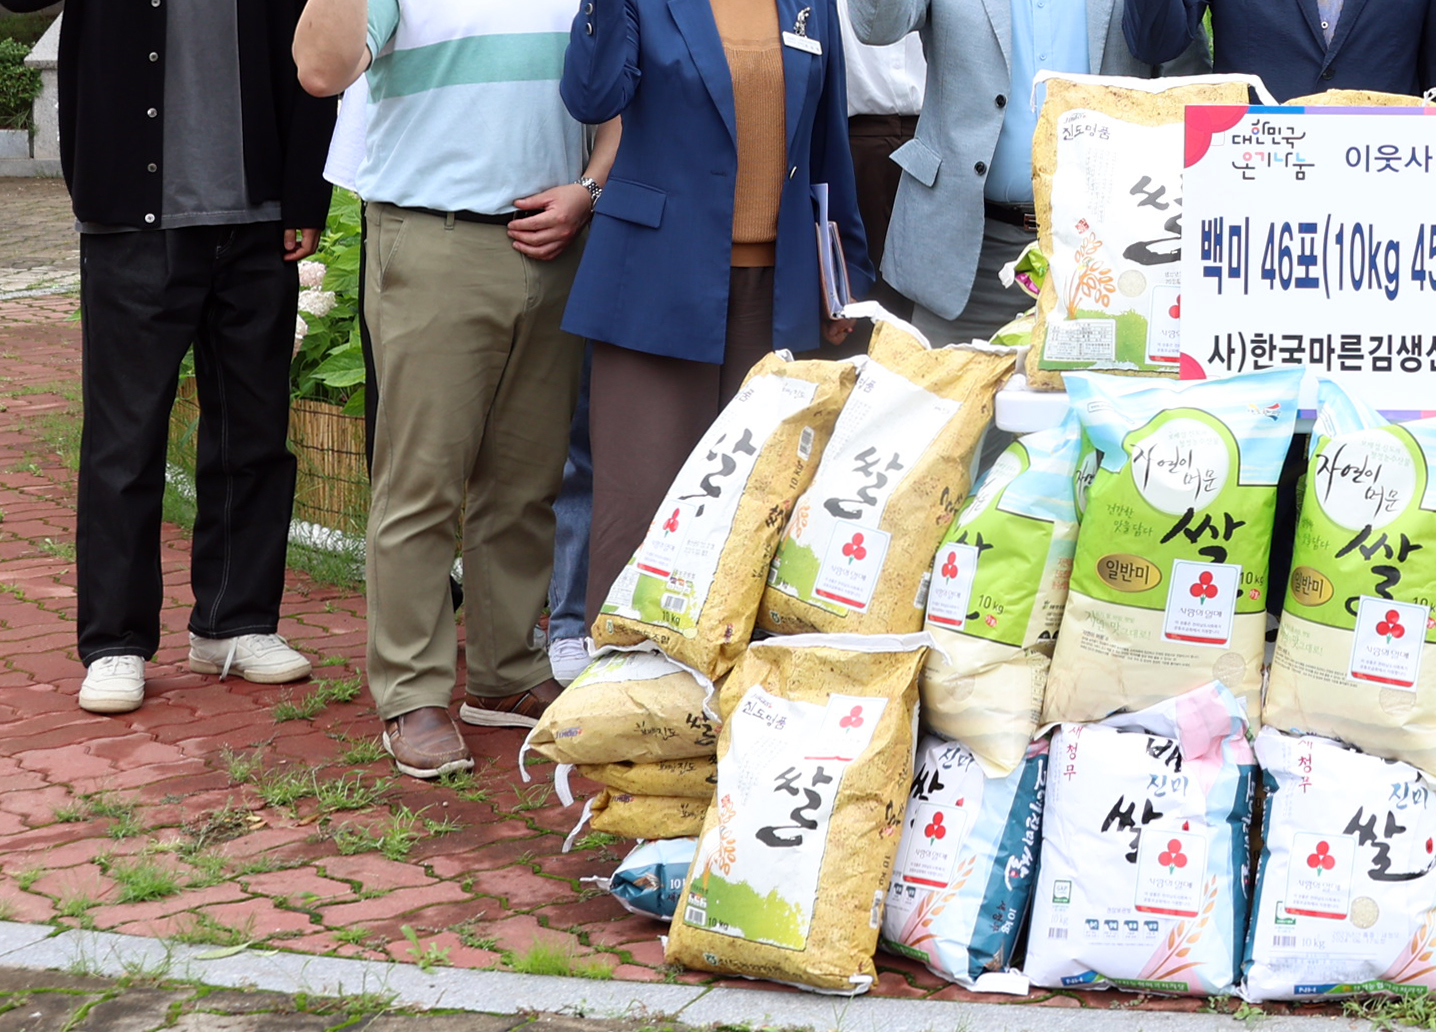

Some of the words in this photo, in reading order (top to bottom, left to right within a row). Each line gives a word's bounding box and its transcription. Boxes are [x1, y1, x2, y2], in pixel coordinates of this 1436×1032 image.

[1232, 119, 1306, 149] 대한민국
[1232, 152, 1315, 180] 온기나눔
[1201, 216, 1250, 295] 백미
[1261, 214, 1400, 301] 46포(10kg
[1130, 443, 1193, 491] 자연이
[1316, 443, 1382, 504] 자연이
[823, 446, 904, 520] 쌀
[1183, 468, 1218, 502] 머문
[1106, 503, 1134, 519] 건강한
[1364, 486, 1399, 517] 머문
[1106, 560, 1150, 585] 일반미
[1240, 572, 1252, 585] 10
[1254, 576, 1264, 586] kg
[1294, 572, 1324, 599] 일반미
[1335, 524, 1423, 618] 쌀
[979, 594, 992, 609] 10
[992, 602, 1004, 614] kg
[686, 712, 716, 746] 쌀
[742, 701, 787, 730] 진도명품
[938, 747, 975, 772] 진미
[1063, 725, 1085, 781] 새청무
[1147, 773, 1189, 797] 진미
[1389, 783, 1428, 810] 진미
[755, 766, 833, 847] 쌀
[1101, 794, 1164, 864] 쌀
[670, 879, 681, 889] 10
[708, 917, 717, 928] 10
[1302, 938, 1312, 947] 10
[1314, 938, 1325, 949] kg
